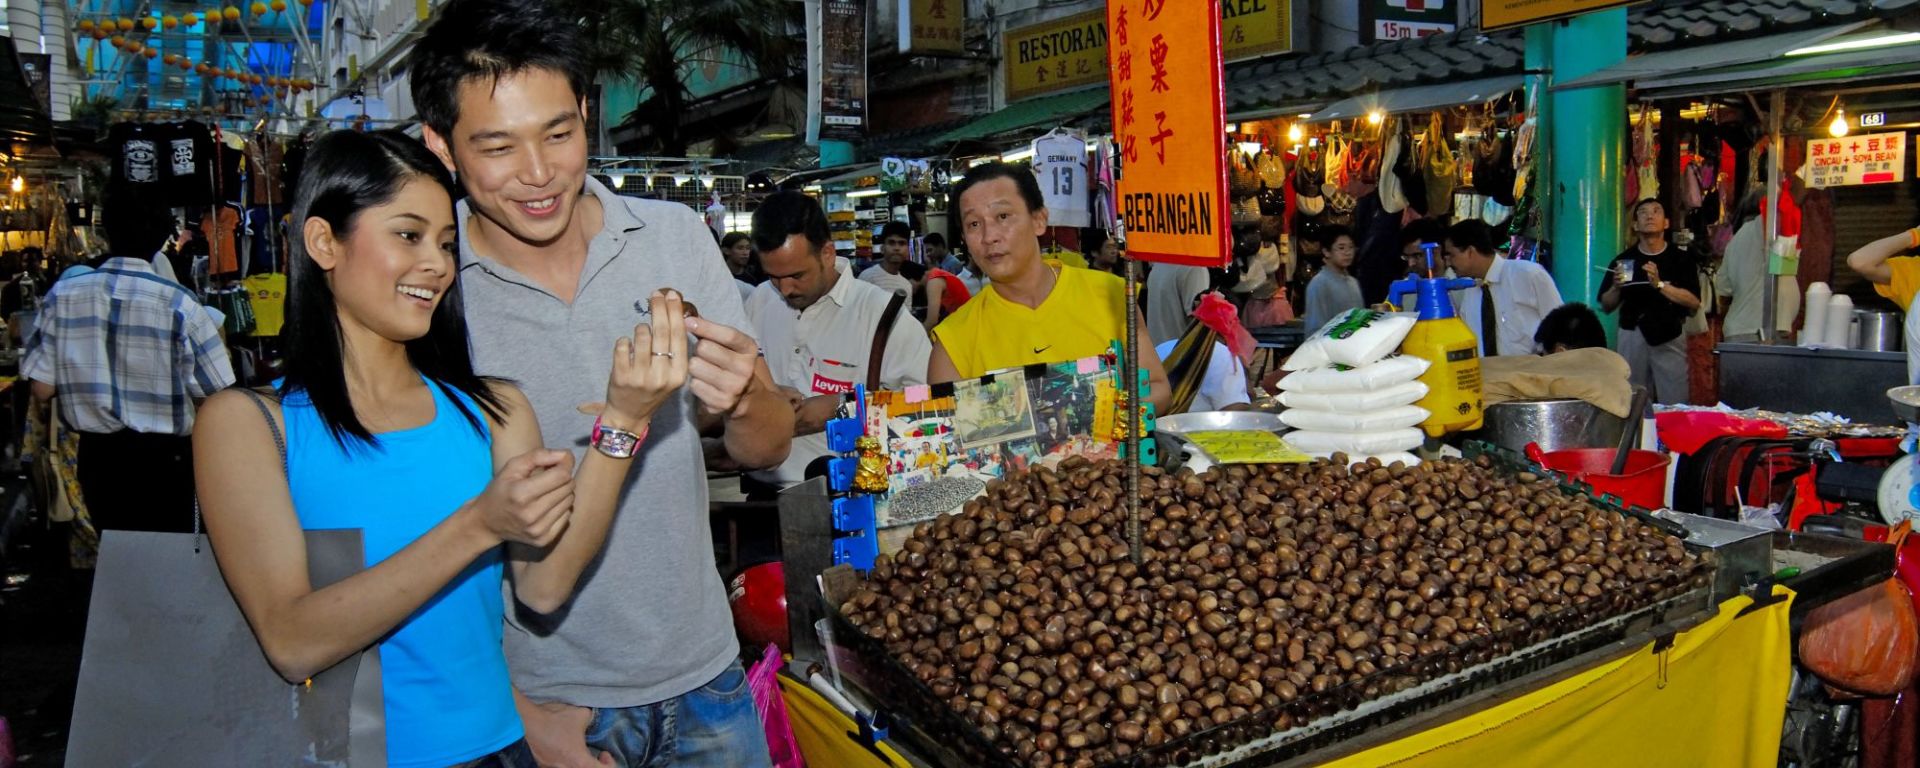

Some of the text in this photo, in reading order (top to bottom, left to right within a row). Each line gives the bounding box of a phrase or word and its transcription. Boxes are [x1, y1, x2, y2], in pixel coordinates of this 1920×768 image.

[1382, 22, 1411, 38] 15m
[1018, 22, 1107, 64] RESTORAN
[1047, 155, 1077, 163] GERMANY
[1853, 154, 1872, 164] SOYA
[1875, 153, 1896, 162] BEAN
[1052, 167, 1073, 196] 13
[1125, 191, 1212, 235] BERANGAN
